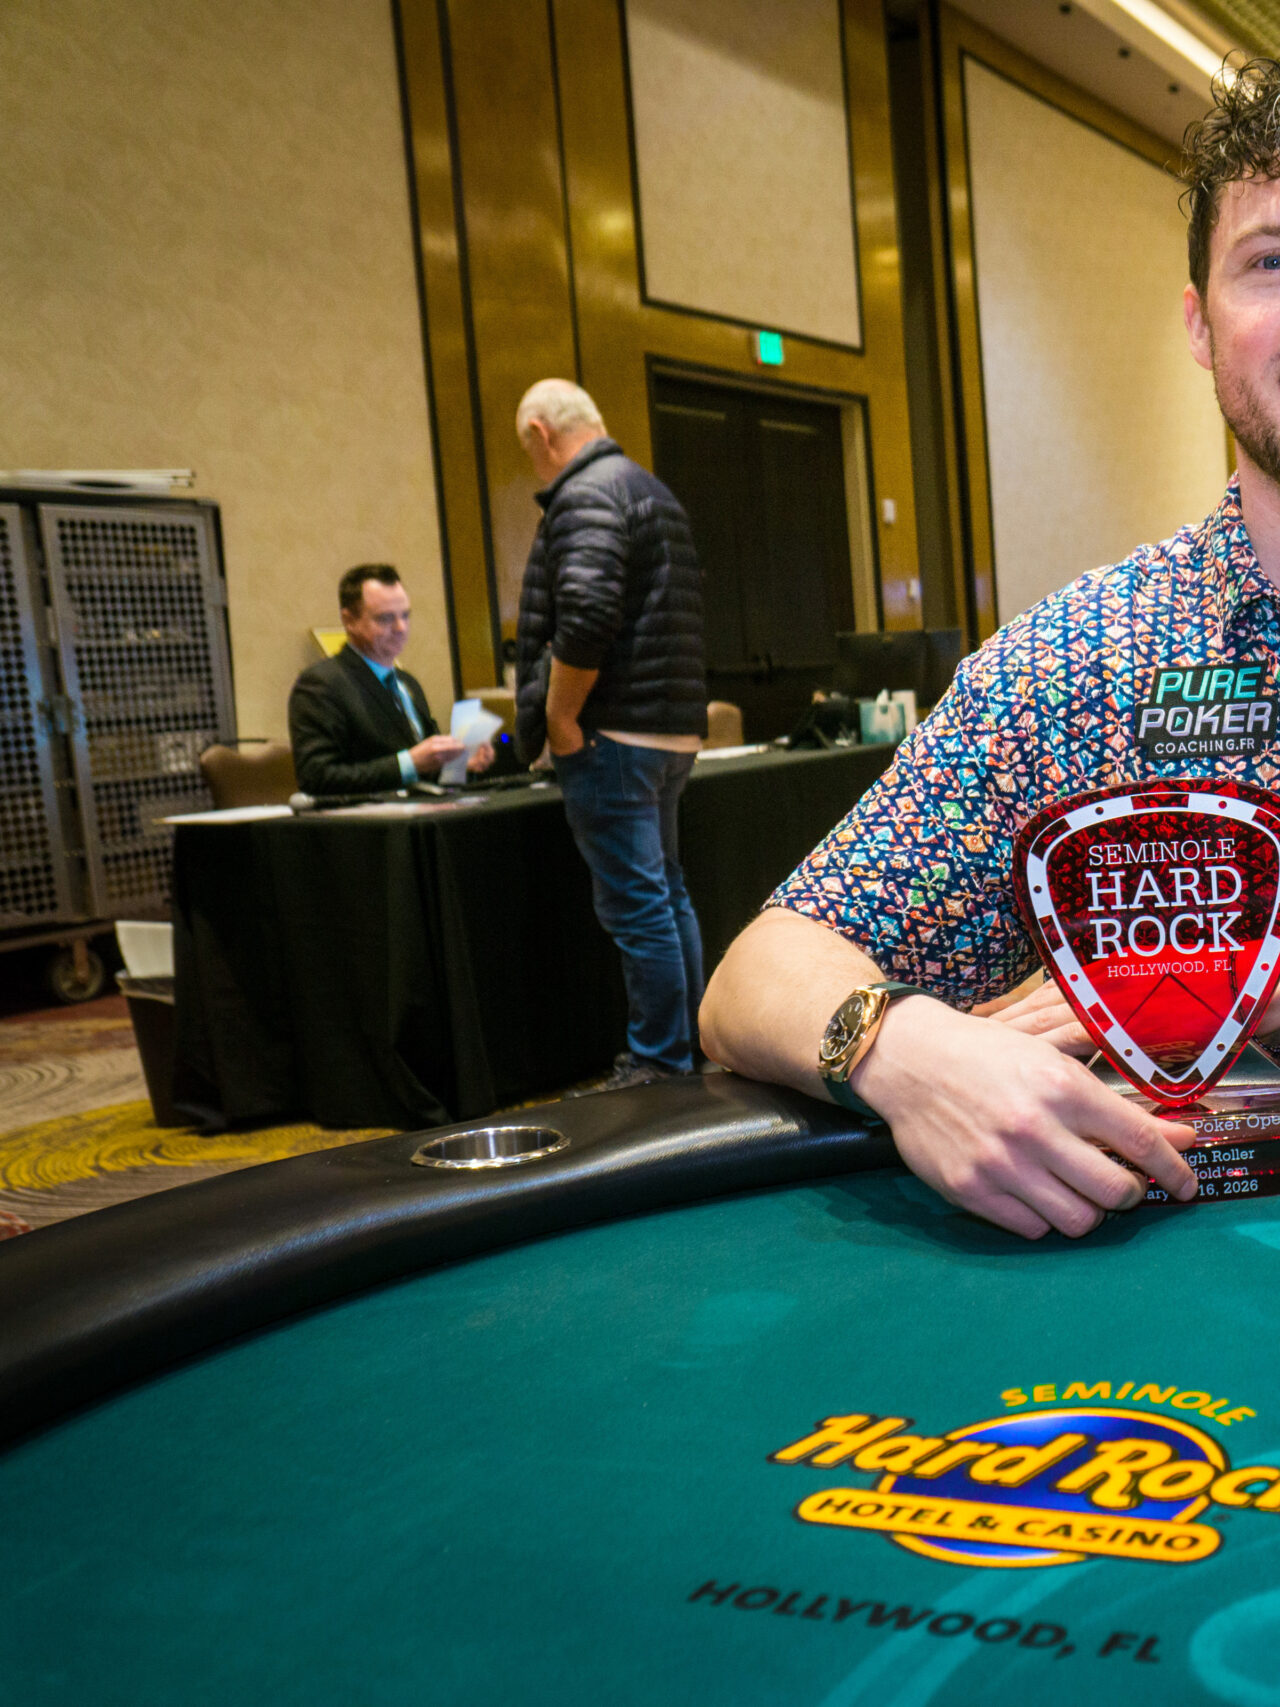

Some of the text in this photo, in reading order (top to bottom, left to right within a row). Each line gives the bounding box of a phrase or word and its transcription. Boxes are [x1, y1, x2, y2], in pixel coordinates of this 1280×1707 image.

[1155, 666, 1262, 704] PURE
[1138, 701, 1272, 739] POKER
[1154, 737, 1255, 755] COACHING.FR
[1088, 837, 1236, 866] SEMINOLE
[1085, 865, 1242, 912] HARD
[1089, 911, 1245, 960] ROCK
[1107, 959, 1232, 978] HOLLYWOOD, FL
[1192, 1118, 1241, 1134] Poker
[1211, 1148, 1255, 1162] Roller
[1223, 1179, 1258, 1194] 2026
[999, 1381, 1257, 1427] SEMINOLE
[772, 1413, 1088, 1488] Hard
[814, 1498, 1201, 1549] HOTEL & CASINO
[687, 1579, 1163, 1664] HOLLYWOOD, FL
